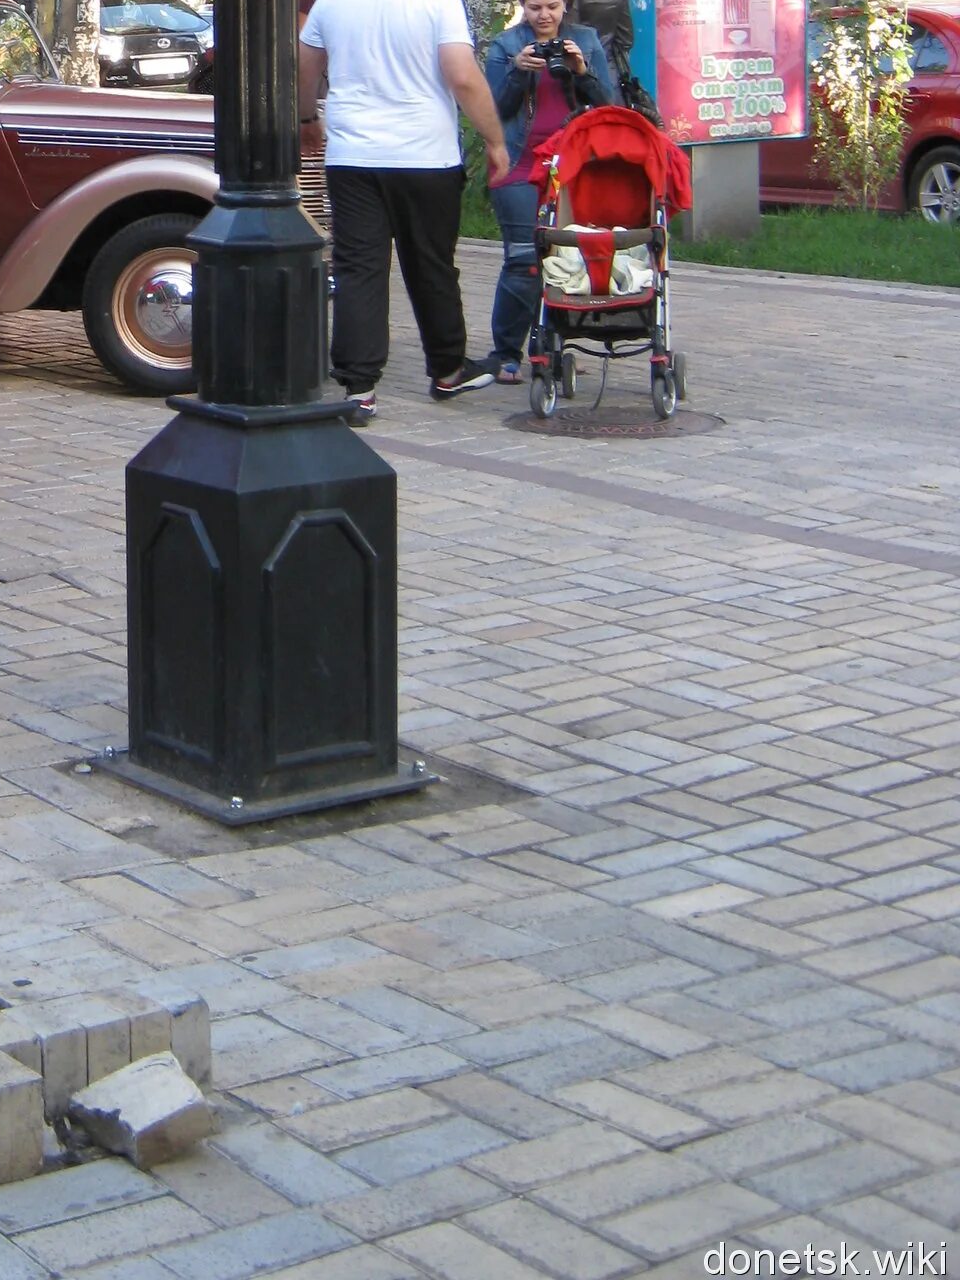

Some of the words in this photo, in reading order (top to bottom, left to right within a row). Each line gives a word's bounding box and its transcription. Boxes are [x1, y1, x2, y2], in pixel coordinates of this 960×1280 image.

[702, 57, 773, 79] Буфет
[692, 78, 784, 98] открыт
[700, 103, 724, 119] на
[733, 96, 786, 117] 100%
